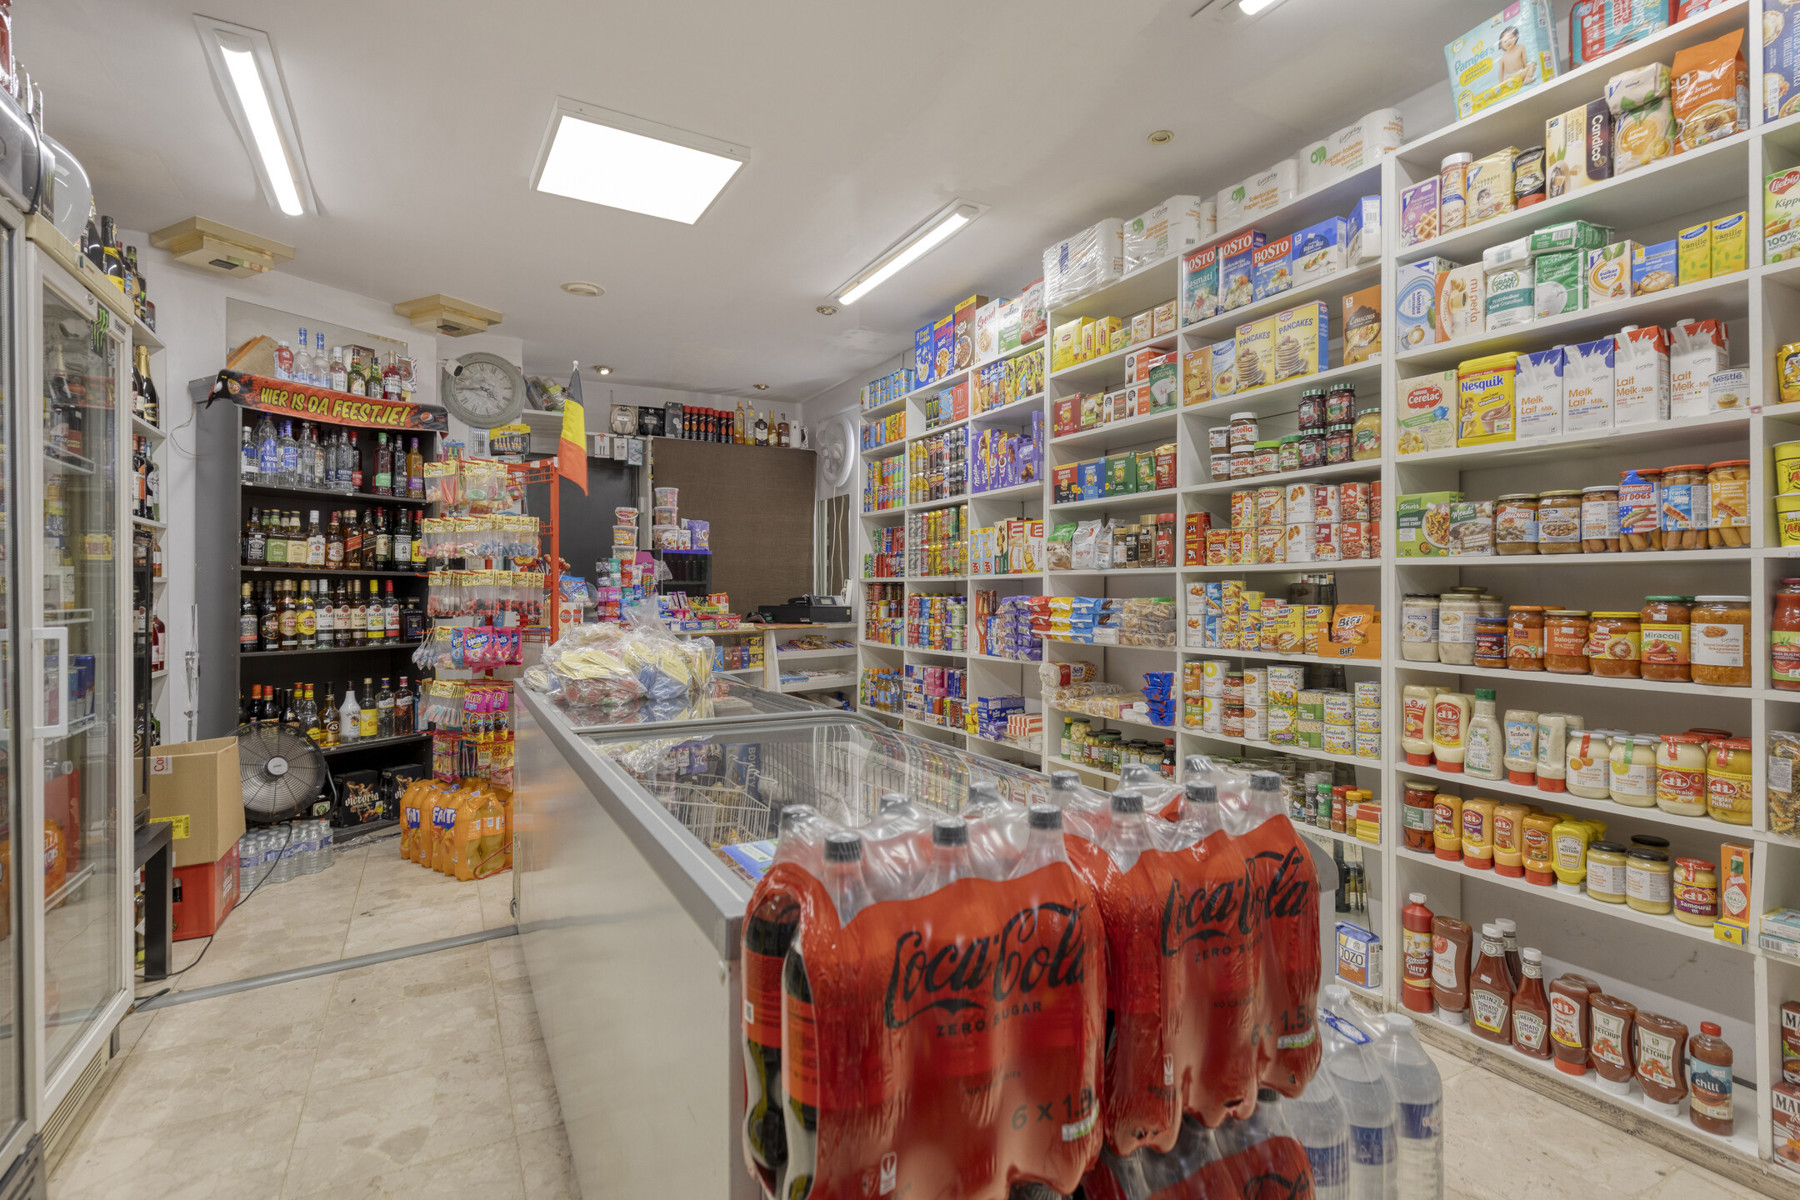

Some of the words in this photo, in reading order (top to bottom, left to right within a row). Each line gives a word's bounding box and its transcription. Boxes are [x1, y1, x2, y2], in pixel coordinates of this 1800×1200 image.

[1454, 46, 1495, 75] Pampers
[1592, 115, 1604, 162] Candico
[1715, 228, 1742, 240] vanille
[1254, 240, 1290, 262] BOSTO
[1278, 318, 1314, 335] PANCAKES
[1239, 331, 1271, 347] PANCAKES
[1616, 376, 1635, 387] Lait
[1672, 371, 1692, 382] Lait
[1461, 375, 1504, 393] Nesquik
[1672, 381, 1695, 392] Melk
[1568, 387, 1593, 397] Melk
[1616, 386, 1637, 397] Melk
[1408, 393, 1440, 405] Cerelac
[1521, 396, 1544, 406] Melk
[1568, 397, 1586, 407] Lait
[261, 387, 287, 407] HIER
[290, 393, 305, 411] IS
[307, 397, 330, 416] DA
[332, 400, 411, 426] FEESTJE!
[1521, 405, 1537, 415] Lait
[1629, 492, 1651, 501] DOGS
[1400, 502, 1420, 511] Knorr
[1338, 615, 1363, 629] BiFi
[1645, 631, 1680, 640] Miracoli
[1340, 647, 1355, 655] BiFi
[1269, 671, 1294, 680] Bonduelle
[1326, 699, 1347, 707] Bonduelle
[1325, 728, 1346, 736] Bonduelle
[1195, 946, 1232, 963] ZERO
[1339, 946, 1364, 966] JOZO
[1406, 963, 1428, 975] Curry
[1478, 993, 1498, 1004] HEINZ
[1477, 1000, 1499, 1013] TOMATO
[936, 1020, 986, 1037] ZERO
[993, 1001, 1042, 1027] SUGAR
[1519, 1014, 1538, 1025] HEINZ
[1518, 1021, 1540, 1032] TOMATO
[1595, 1026, 1621, 1041] KETCHUP
[1641, 1047, 1672, 1061] KETCHUP
